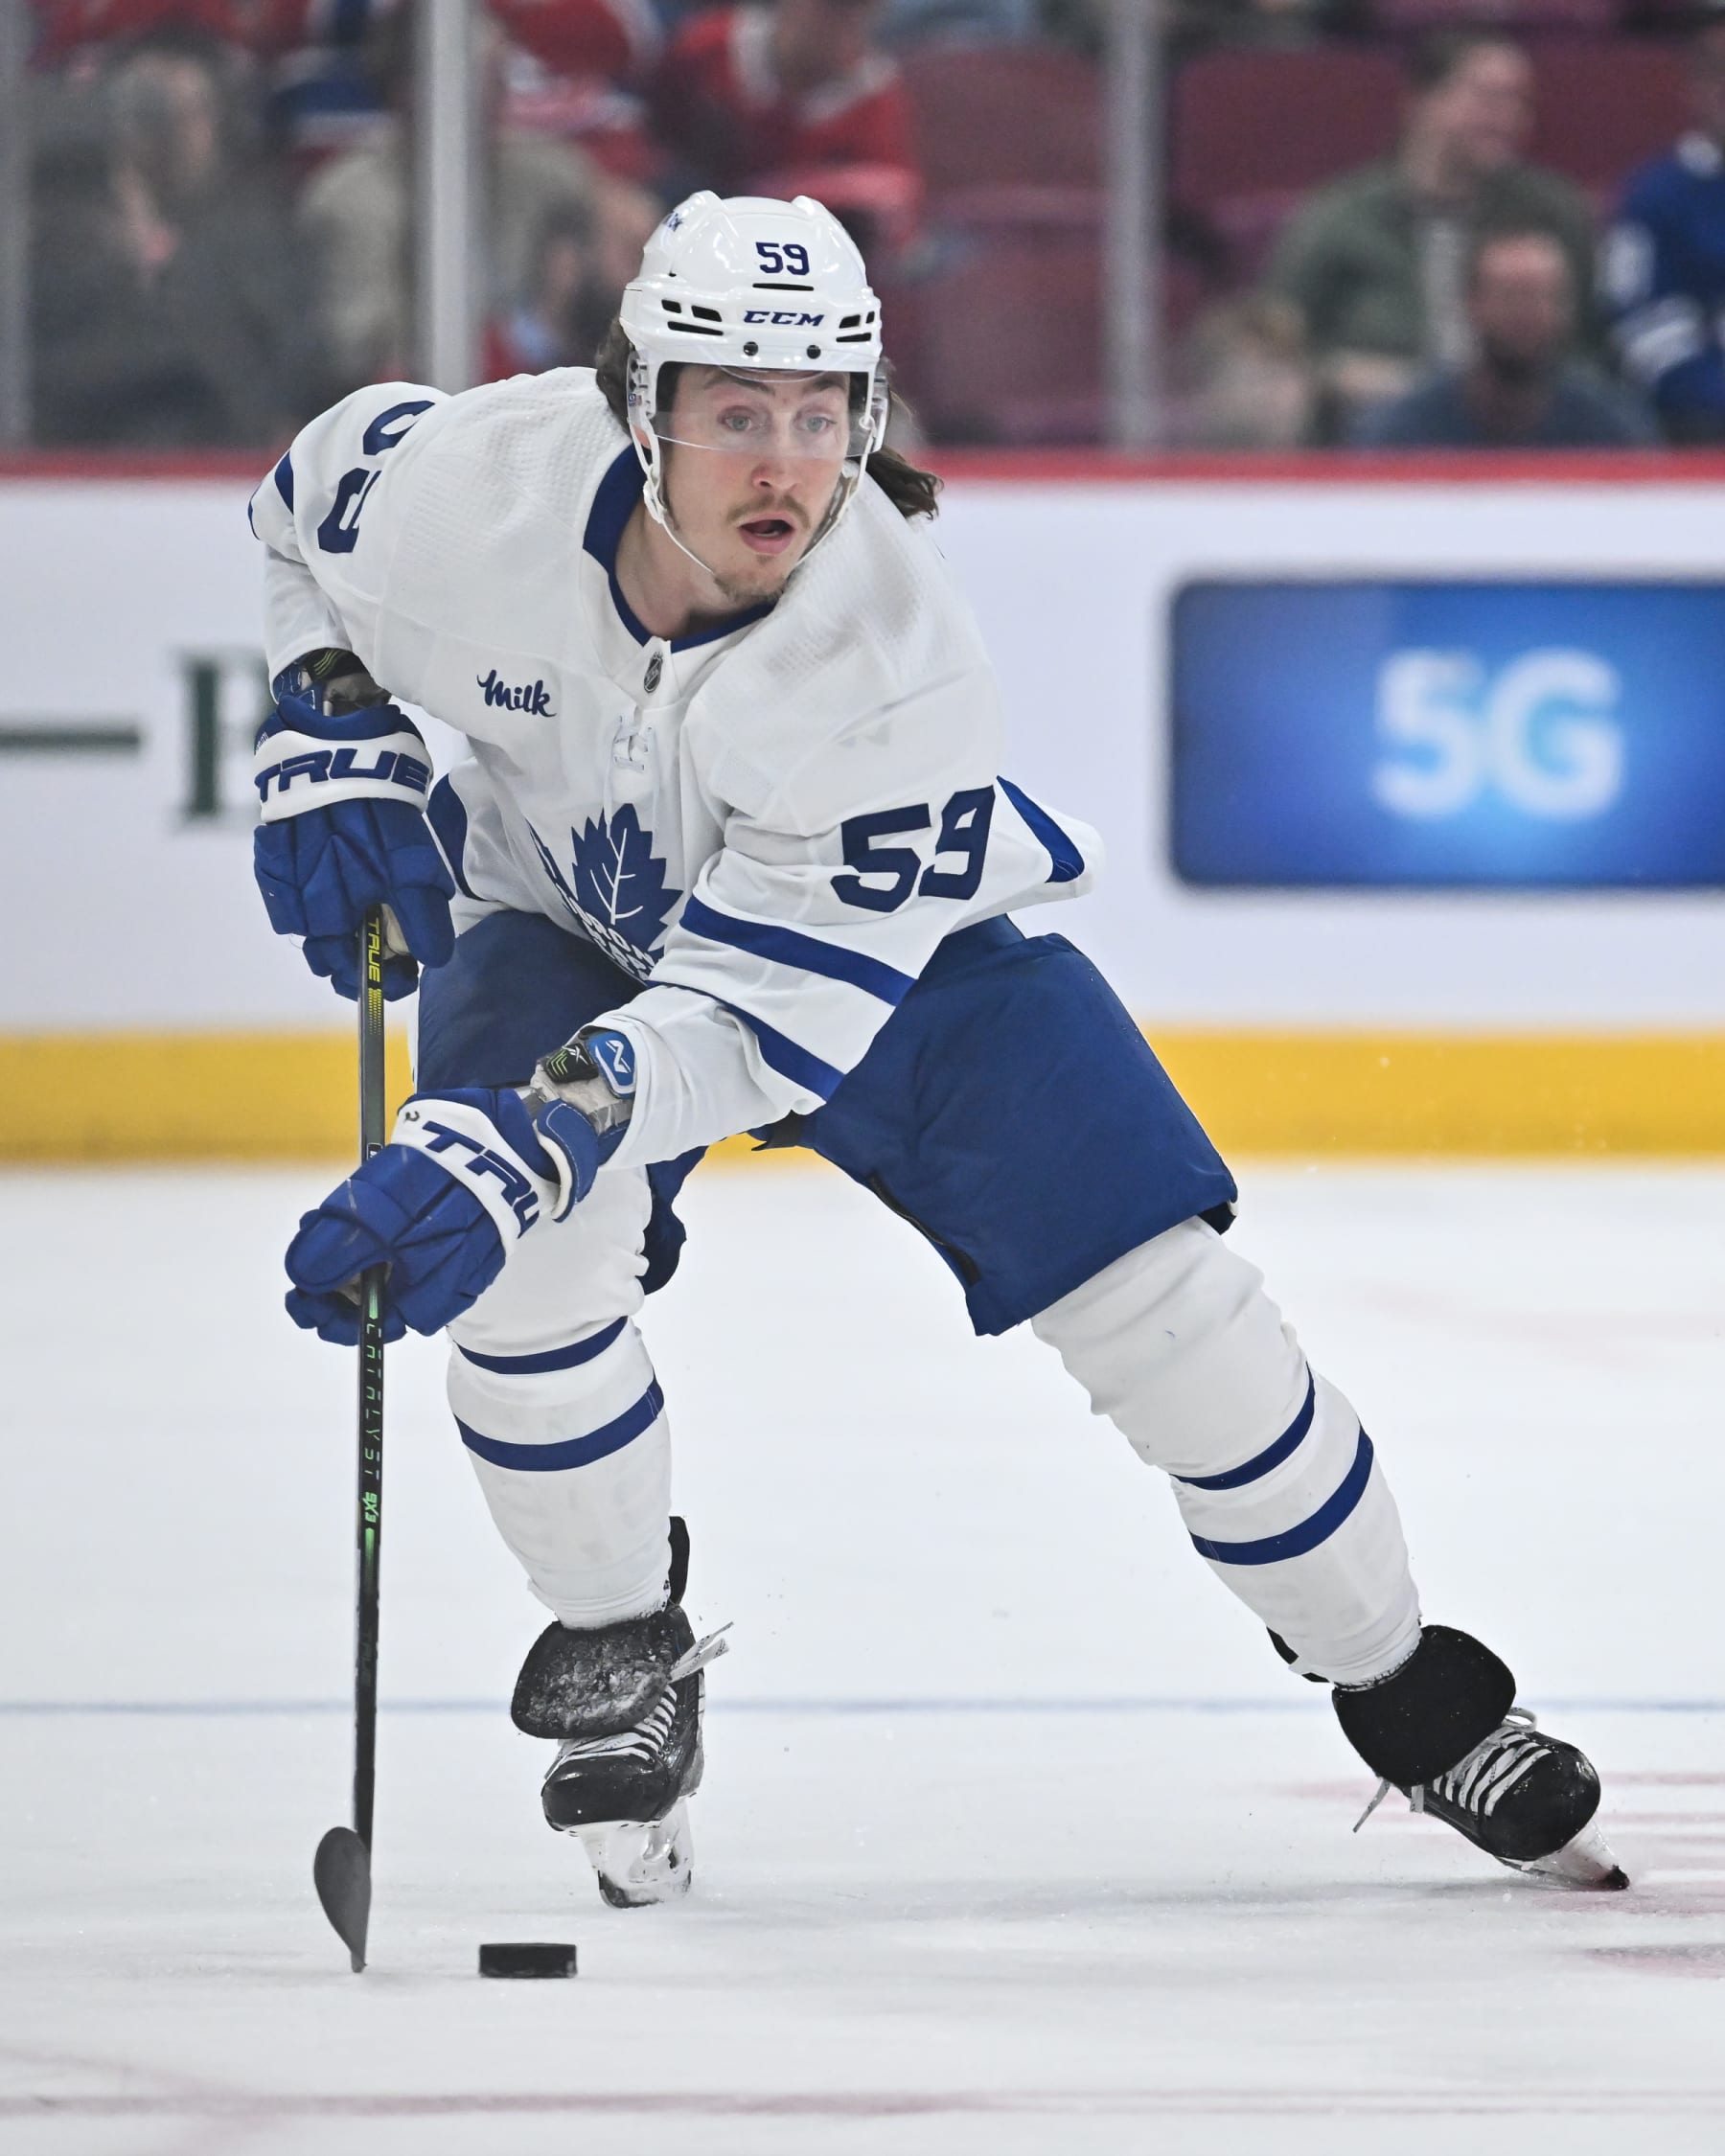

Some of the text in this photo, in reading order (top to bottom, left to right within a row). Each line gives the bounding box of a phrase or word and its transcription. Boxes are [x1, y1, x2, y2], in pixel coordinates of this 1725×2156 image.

[755, 241, 810, 275] 59
[743, 310, 824, 327] CCM
[477, 669, 558, 718] Milk
[1374, 647, 1622, 821] 5G
[254, 747, 430, 803] TRUE
[830, 784, 996, 913] 59
[367, 916, 381, 983] TRUE
[364, 1322, 382, 1480] CATALYST
